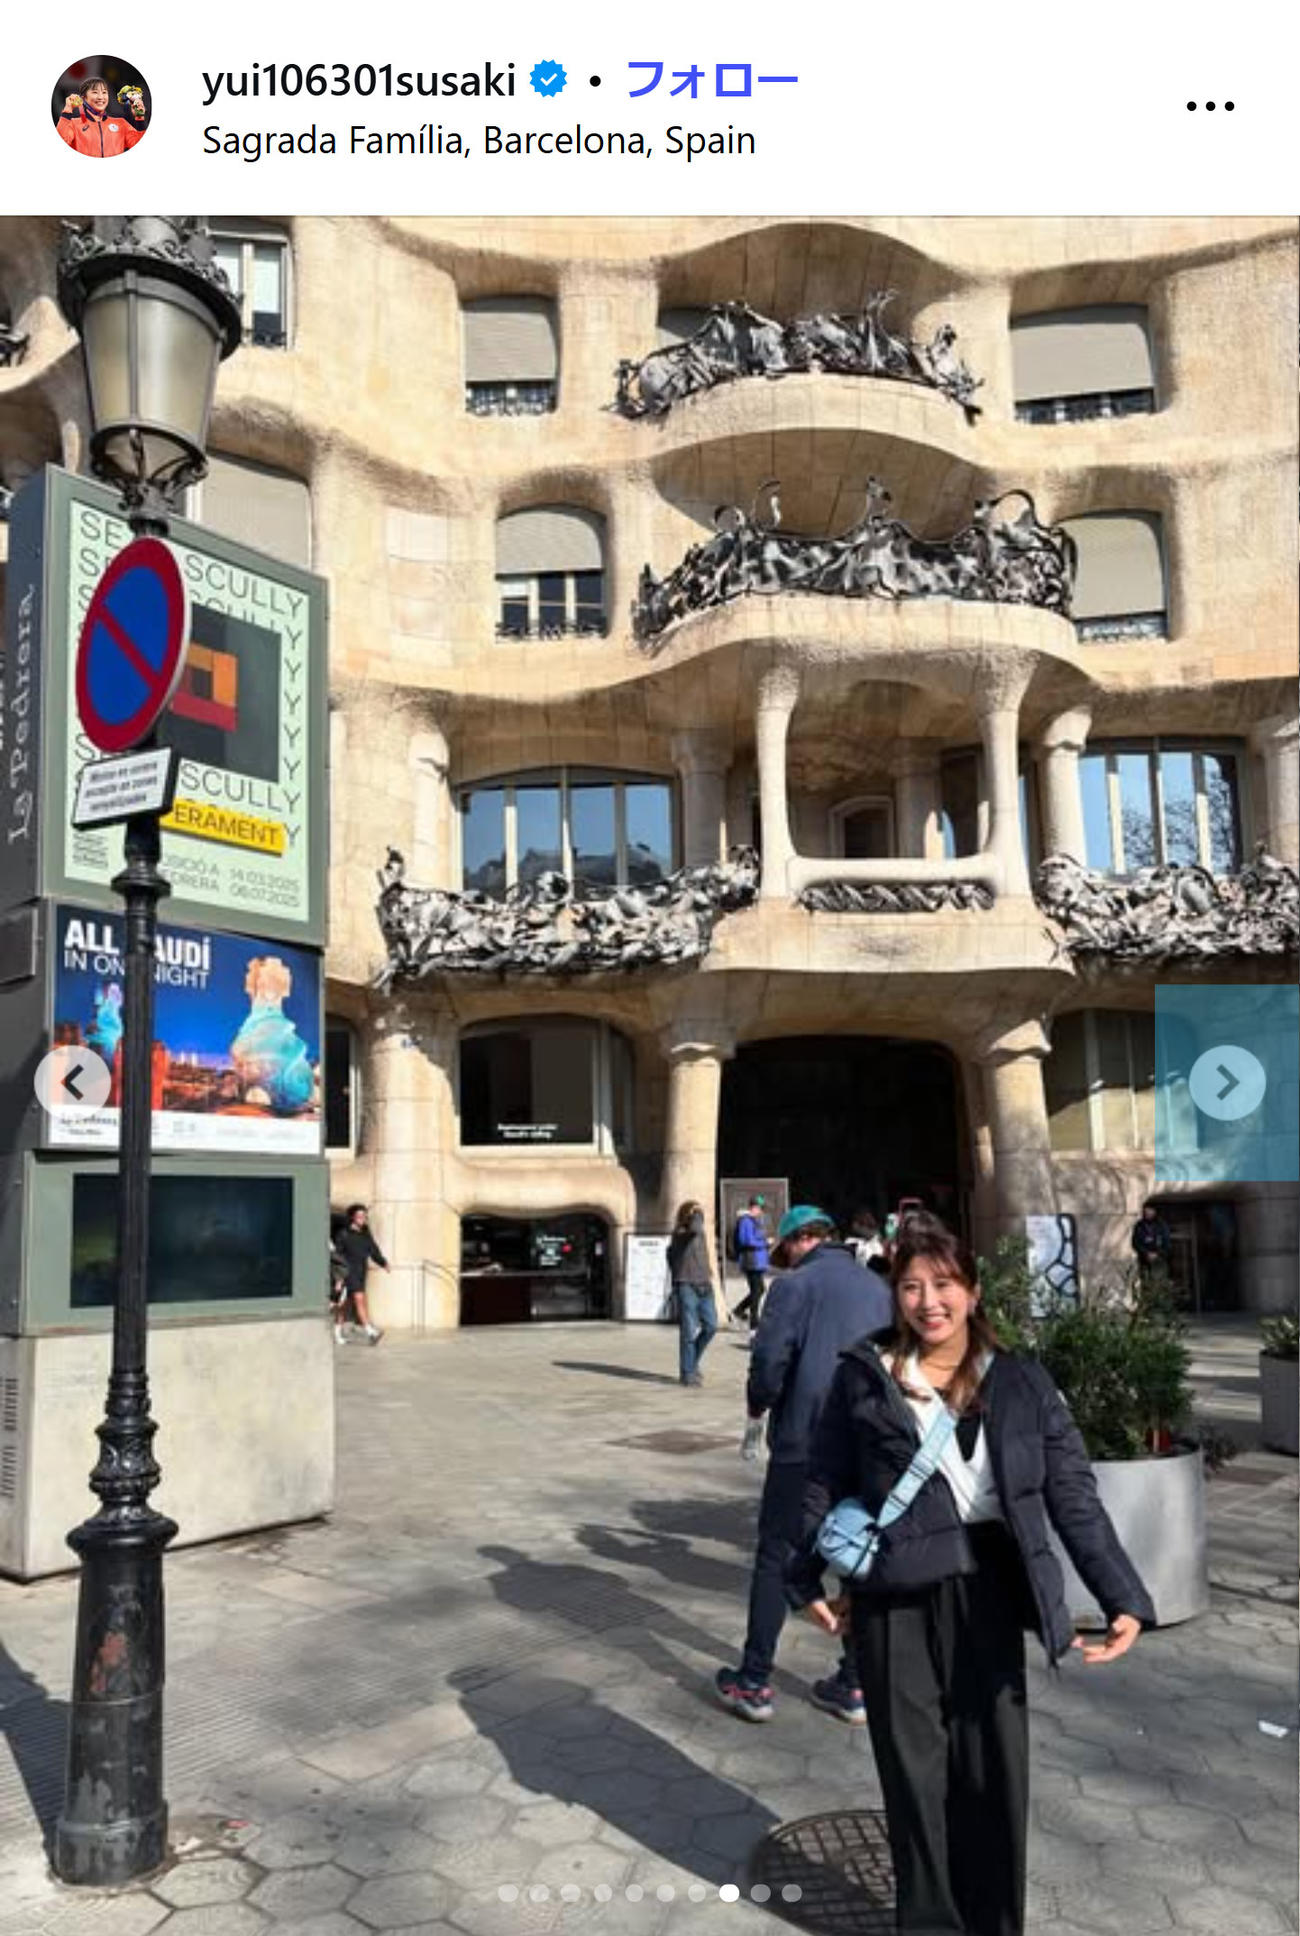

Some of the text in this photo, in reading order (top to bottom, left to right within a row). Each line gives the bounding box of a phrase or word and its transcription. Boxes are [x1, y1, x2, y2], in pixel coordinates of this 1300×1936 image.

[184, 553, 303, 619] SCULLY
[180, 762, 301, 815] SCULLY
[174, 802, 281, 847] ERAMENT
[64, 919, 211, 970] ALL AUDÍ
[64, 950, 87, 971] IN
[94, 954, 125, 977] ON
